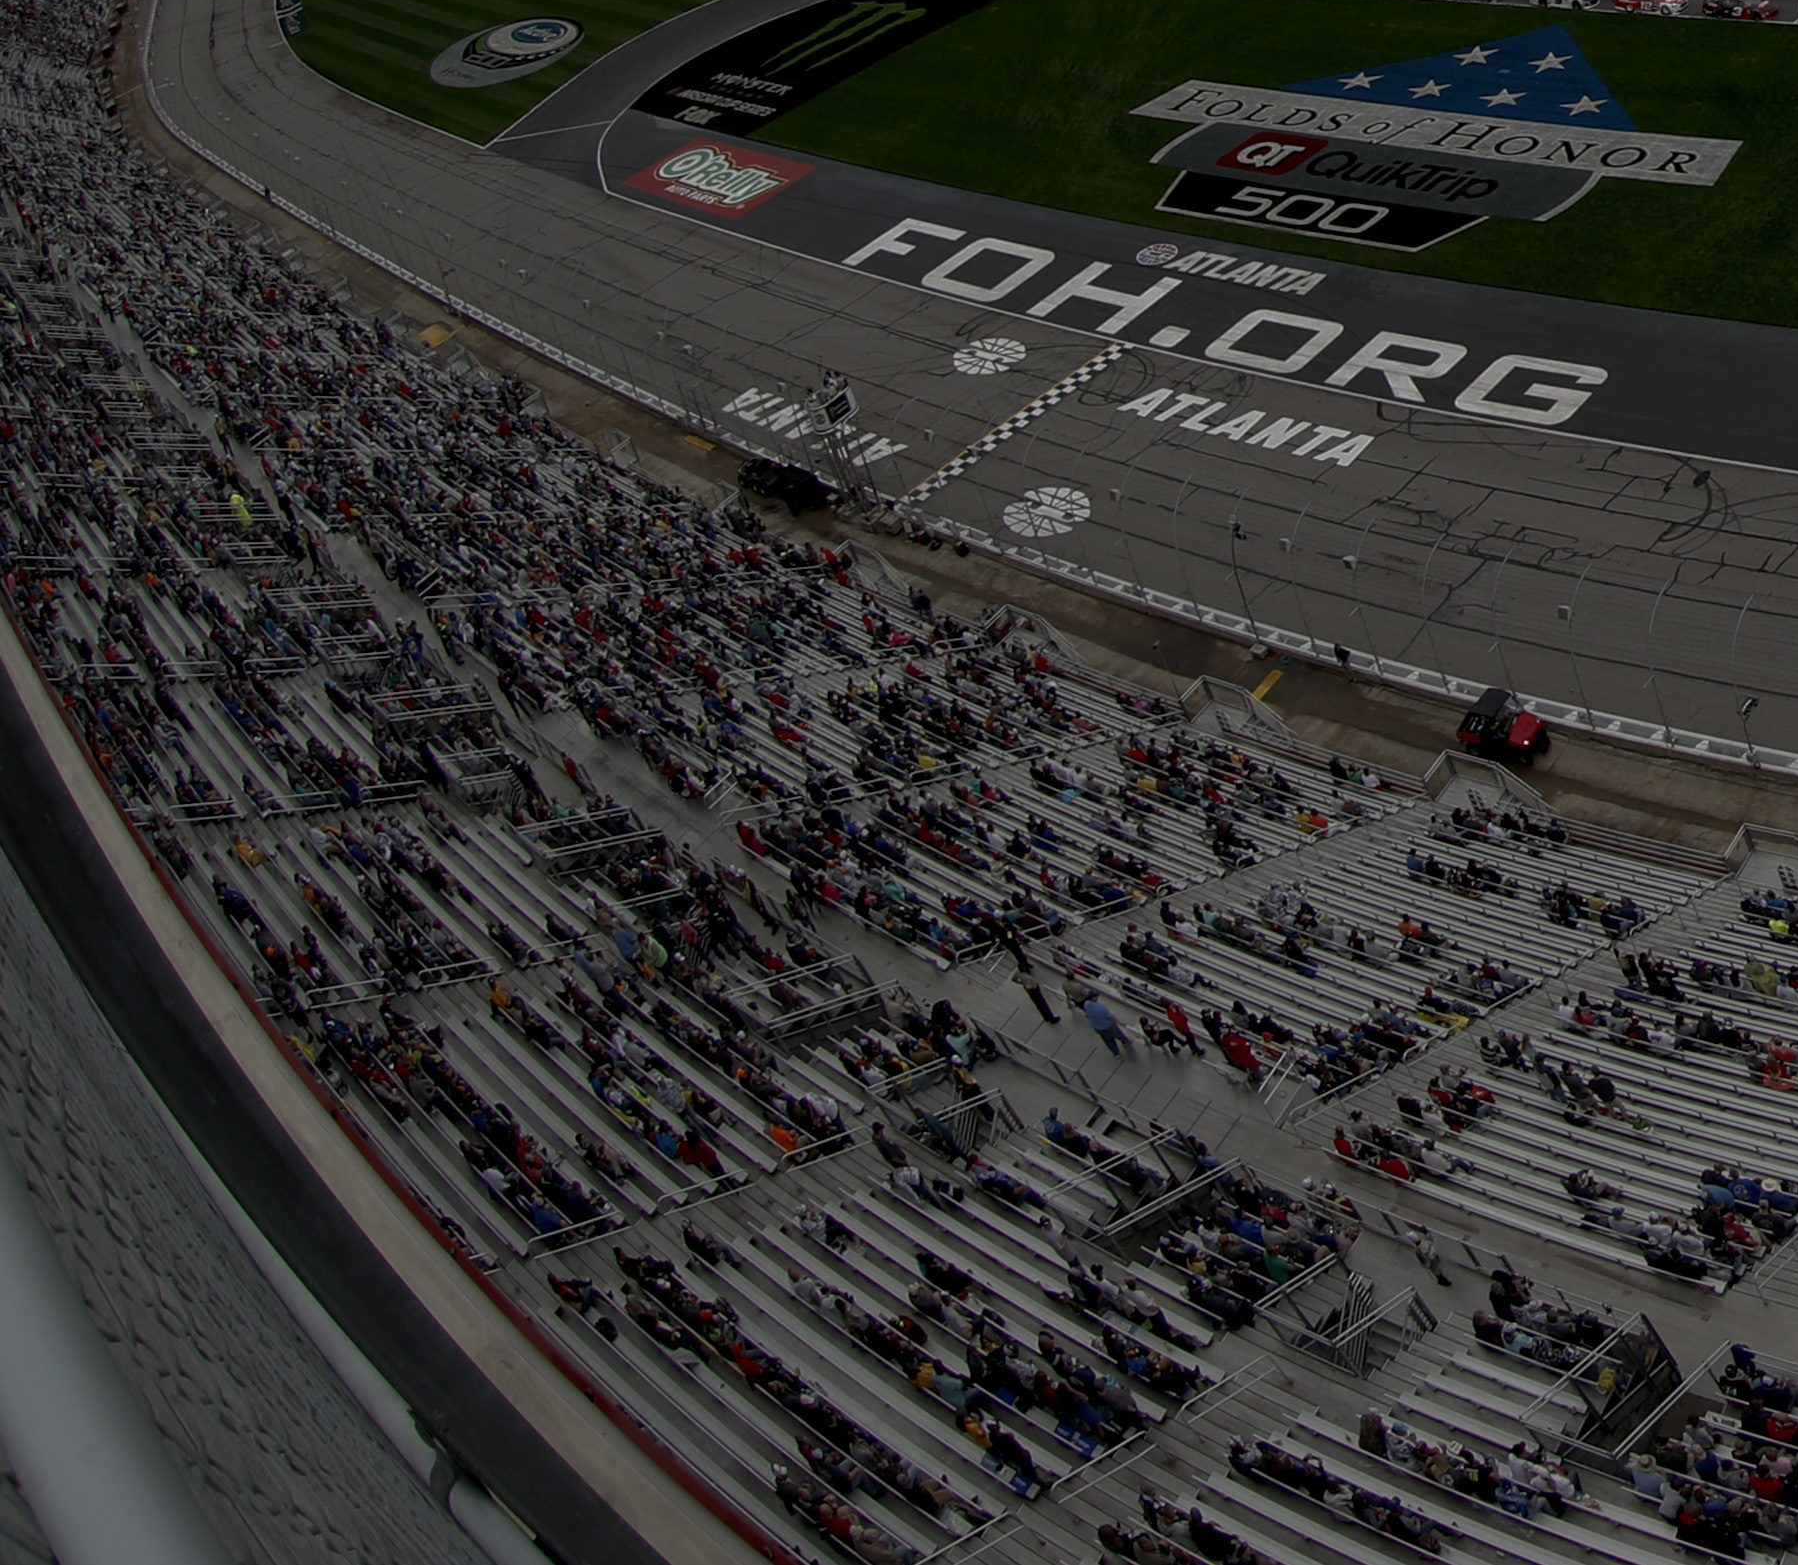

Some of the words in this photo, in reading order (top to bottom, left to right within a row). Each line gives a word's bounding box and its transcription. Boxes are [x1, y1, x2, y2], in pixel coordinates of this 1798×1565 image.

[1641, 1, 1652, 11] 12
[1731, 6, 1743, 17] 3
[710, 71, 793, 97] MONSTER
[672, 105, 723, 125] FOX
[1166, 88, 1353, 133] FOLDS
[1362, 116, 1421, 146] of
[1432, 122, 1698, 176] HONOR
[658, 147, 781, 204] O'Reilly
[664, 184, 690, 197] AUTO
[686, 190, 718, 204] PARTS
[1234, 141, 1307, 171] QT
[1305, 149, 1499, 203] QuikTrip
[1213, 187, 1391, 235] 500
[1169, 249, 1328, 296] ATLANTA
[842, 217, 1609, 426] FOH.ORG
[1116, 387, 1376, 469] ATLANTA
